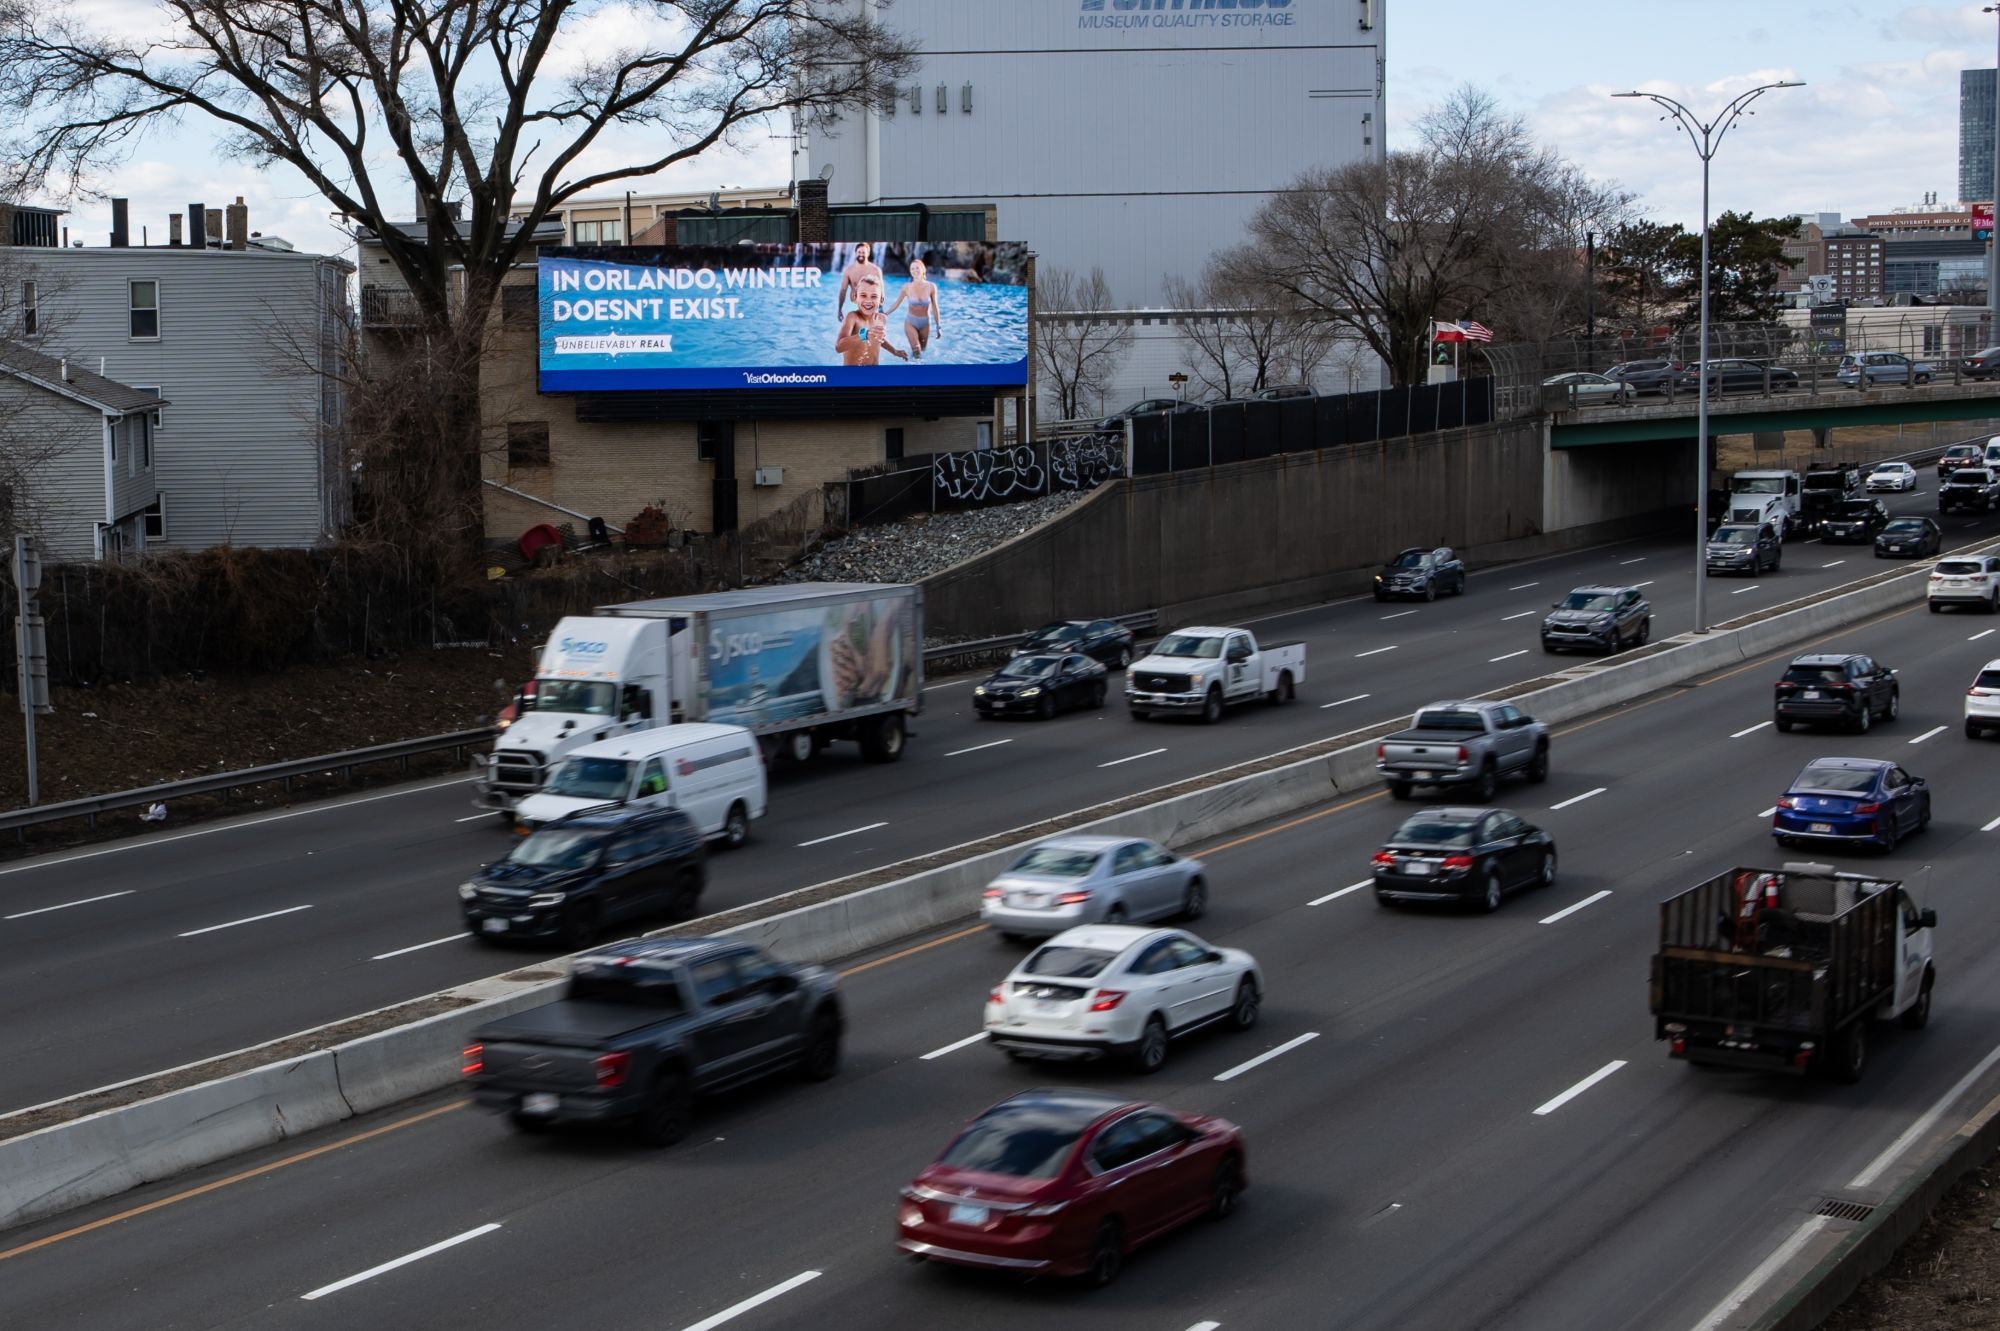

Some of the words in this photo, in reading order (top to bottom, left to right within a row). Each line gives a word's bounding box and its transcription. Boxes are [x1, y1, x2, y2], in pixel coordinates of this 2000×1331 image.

[1078, 15, 1149, 29] MUSEUM
[1152, 14, 1219, 28] QUALITY
[1221, 13, 1294, 27] STORAGE
[553, 269, 580, 291] IN
[584, 268, 723, 295] ORLANDO,
[723, 266, 822, 289] WINTER
[553, 298, 664, 321] DOESN'T
[669, 297, 745, 320] EXIST.
[561, 339, 638, 350] UNBELIEVABLY
[639, 339, 666, 348] REAL
[742, 371, 827, 384] VisitOrlando.com
